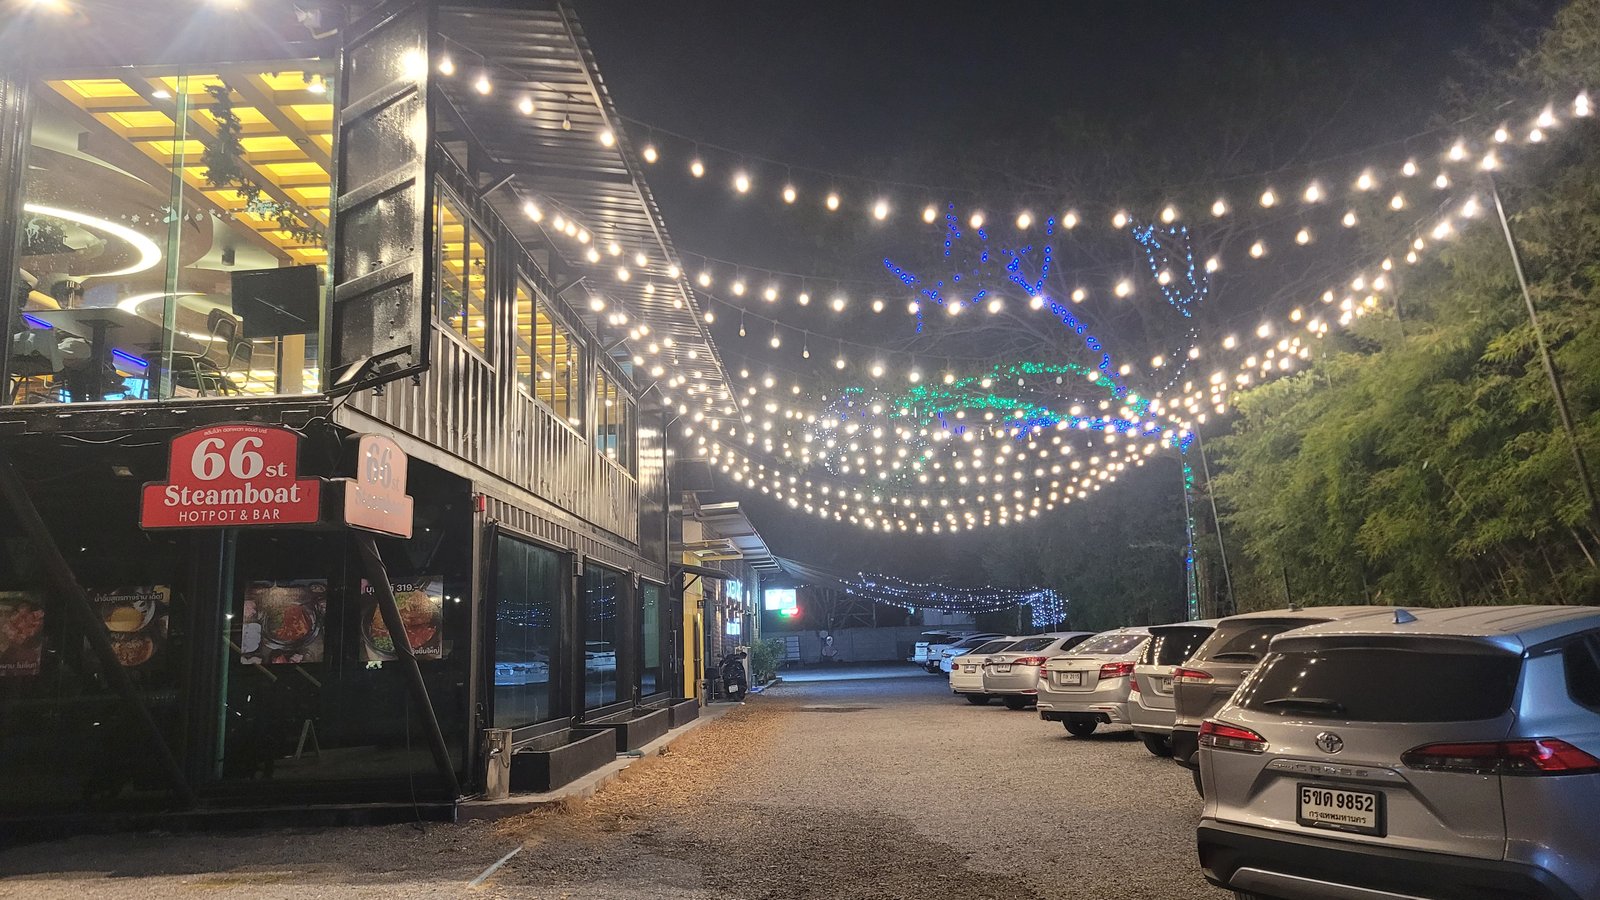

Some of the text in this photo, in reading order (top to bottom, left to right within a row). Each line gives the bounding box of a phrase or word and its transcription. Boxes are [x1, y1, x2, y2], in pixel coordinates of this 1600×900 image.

[164, 482, 301, 507] Steamboat
[179, 508, 280, 522] HOTPOT & BAR
[1303, 789, 1374, 812] 5ขด 9852
[1308, 810, 1367, 824] กรุงเทพมหานคร
